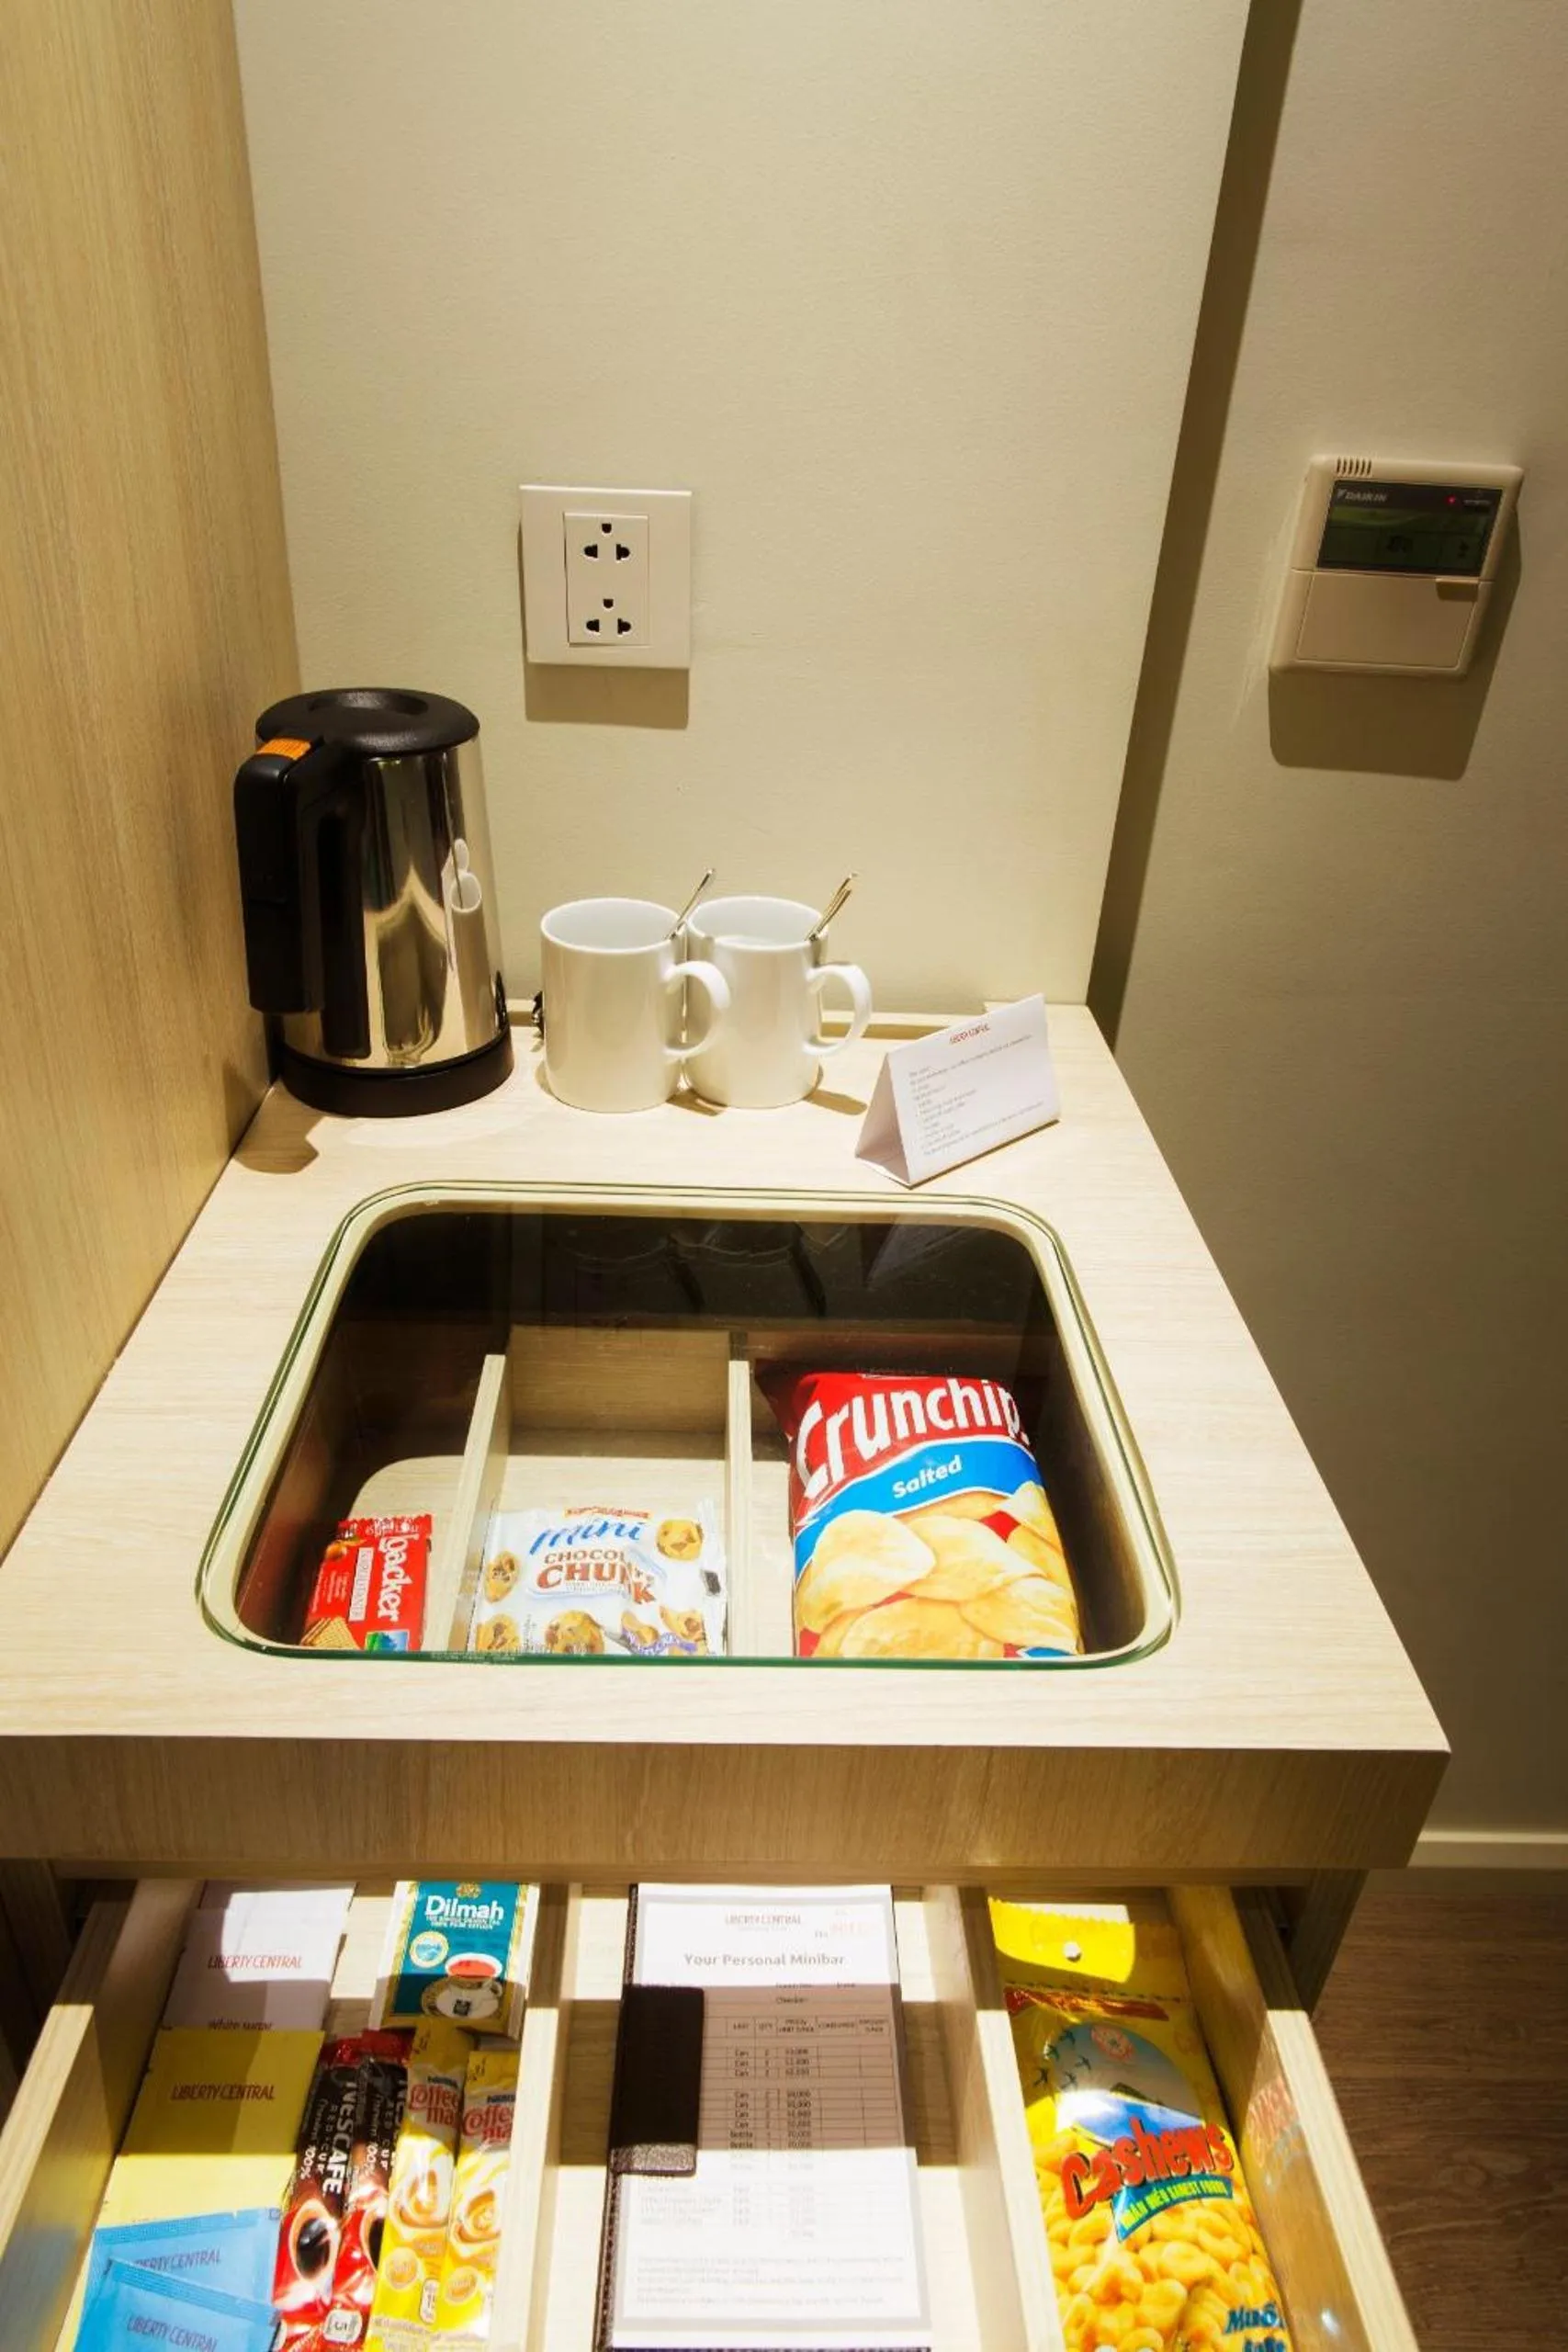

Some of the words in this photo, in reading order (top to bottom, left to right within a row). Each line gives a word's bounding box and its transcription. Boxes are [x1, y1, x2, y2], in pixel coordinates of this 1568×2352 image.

[796, 1379, 1030, 1499] Crunchip
[892, 1455, 963, 1499] Salted
[529, 1519, 647, 1555] mini
[424, 1895, 504, 1922] Dilmah
[208, 1954, 254, 1970] LIBERTY
[253, 1955, 303, 1969] CENTRAL
[684, 1953, 717, 1966] Your
[723, 1953, 786, 1967] Personal
[790, 1953, 845, 1966] Minibar
[171, 2083, 220, 2100] LIBERTY
[220, 2084, 276, 2100] CENTRAL
[426, 2107, 455, 2126] ma
[463, 2105, 513, 2137] Coffe
[1062, 2117, 1235, 2221] Cashews
[170, 2248, 220, 2270] CENTRAL
[127, 2314, 172, 2337] LIBERTY
[168, 2325, 218, 2352] CENTRAL
